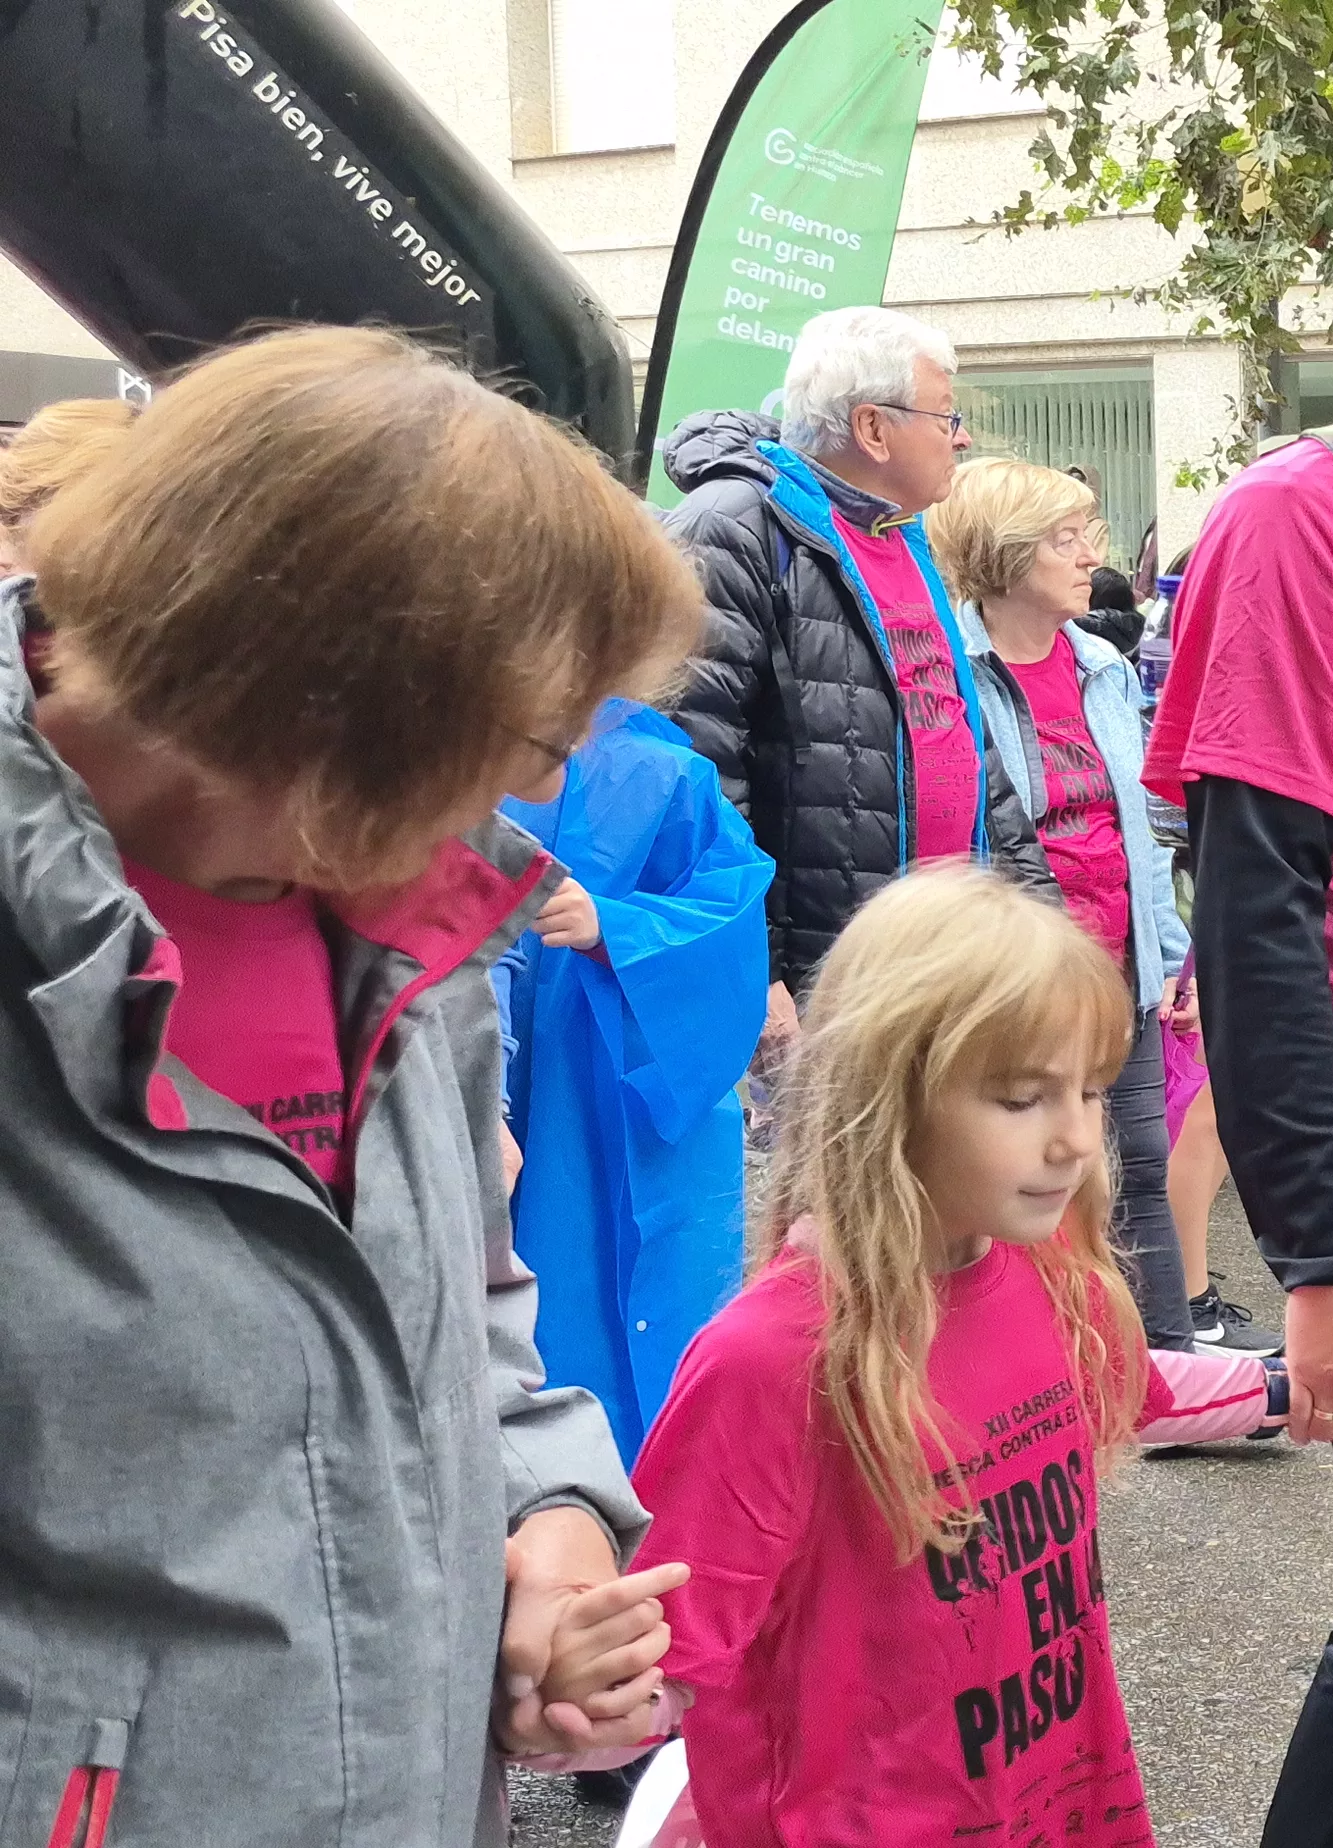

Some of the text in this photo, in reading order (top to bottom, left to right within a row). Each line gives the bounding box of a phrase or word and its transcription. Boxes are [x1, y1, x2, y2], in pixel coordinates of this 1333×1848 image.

[179, 0, 481, 306] Pisa bien, vive mejor
[750, 192, 862, 251] Tenemos
[737, 226, 835, 273] un gran
[724, 285, 770, 313] por
[730, 257, 827, 300] camino
[717, 313, 801, 353] delan
[953, 1636, 1086, 1781] PASO
